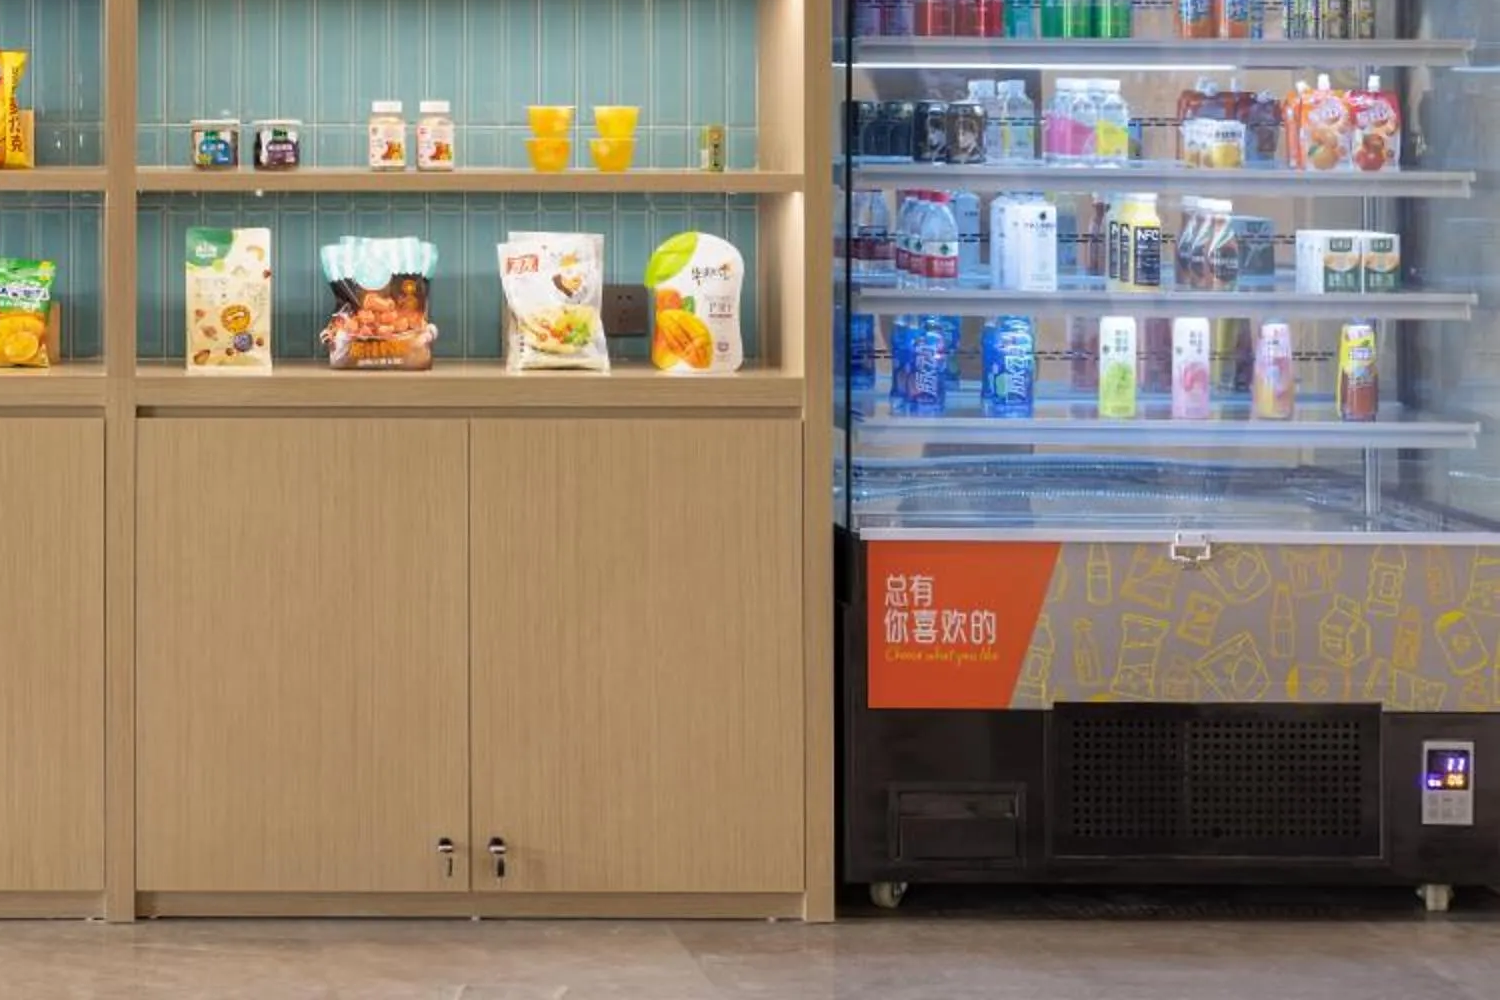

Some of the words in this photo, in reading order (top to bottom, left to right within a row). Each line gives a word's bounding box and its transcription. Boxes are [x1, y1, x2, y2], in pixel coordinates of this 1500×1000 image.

[884, 573, 934, 608] 总有
[884, 608, 997, 645] 你喜欢的
